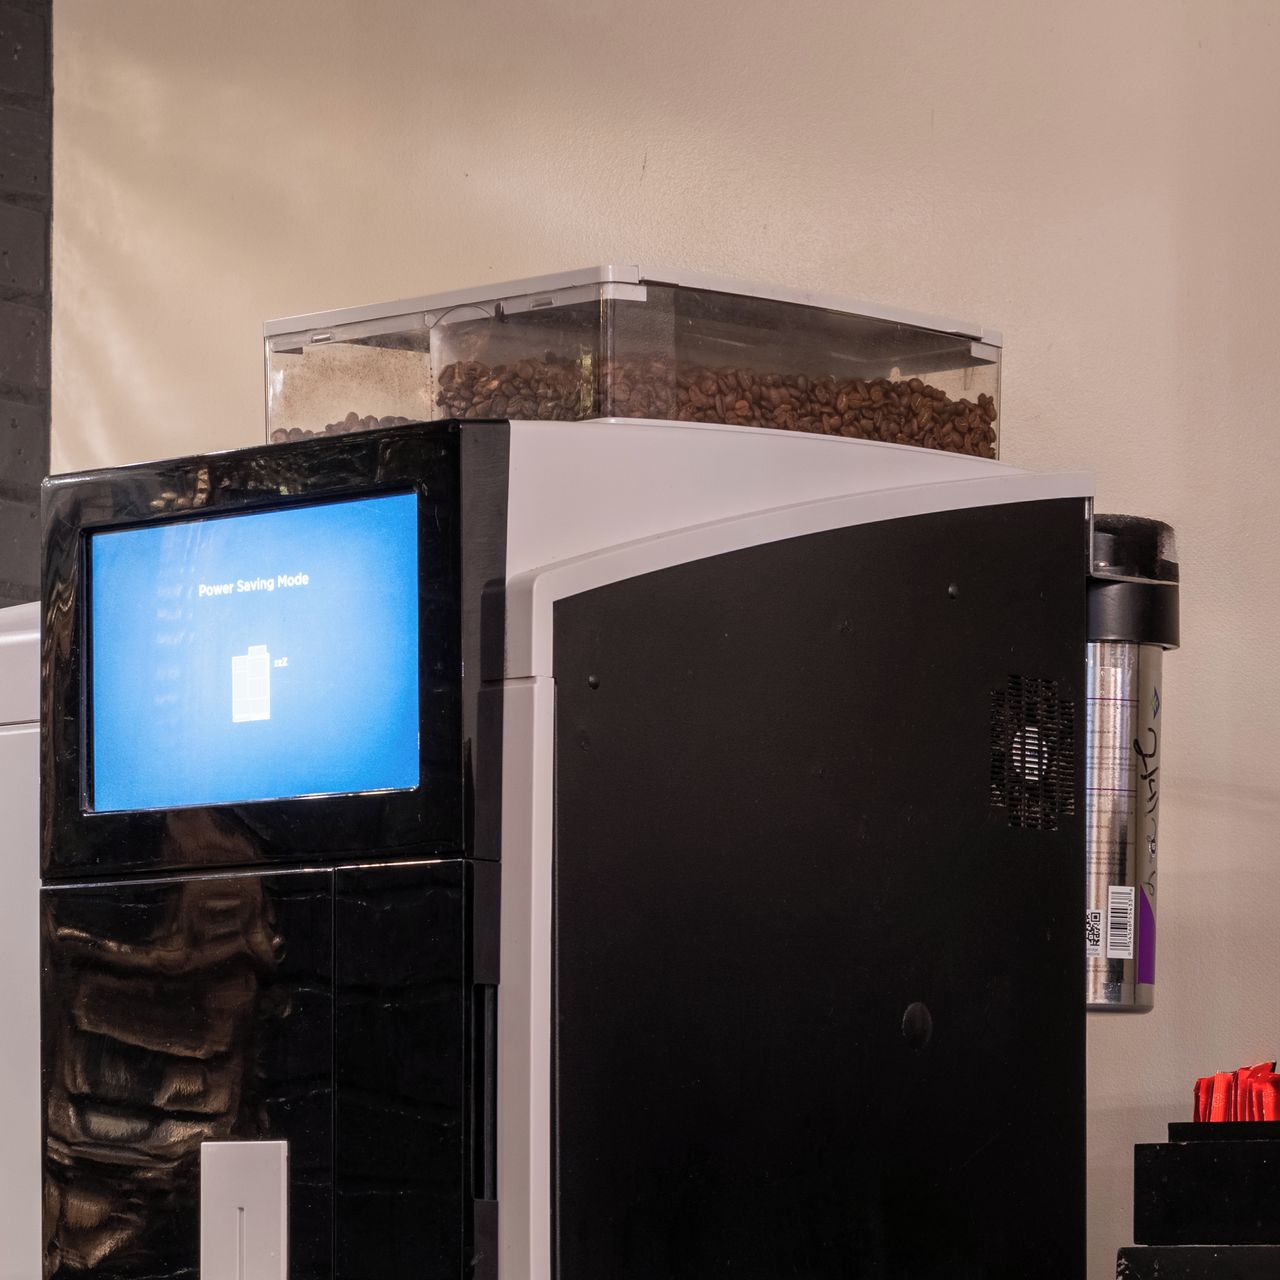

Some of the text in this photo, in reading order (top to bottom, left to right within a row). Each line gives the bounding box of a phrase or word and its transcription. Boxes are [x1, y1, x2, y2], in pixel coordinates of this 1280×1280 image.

[198, 572, 309, 597] Power Saving Mode
